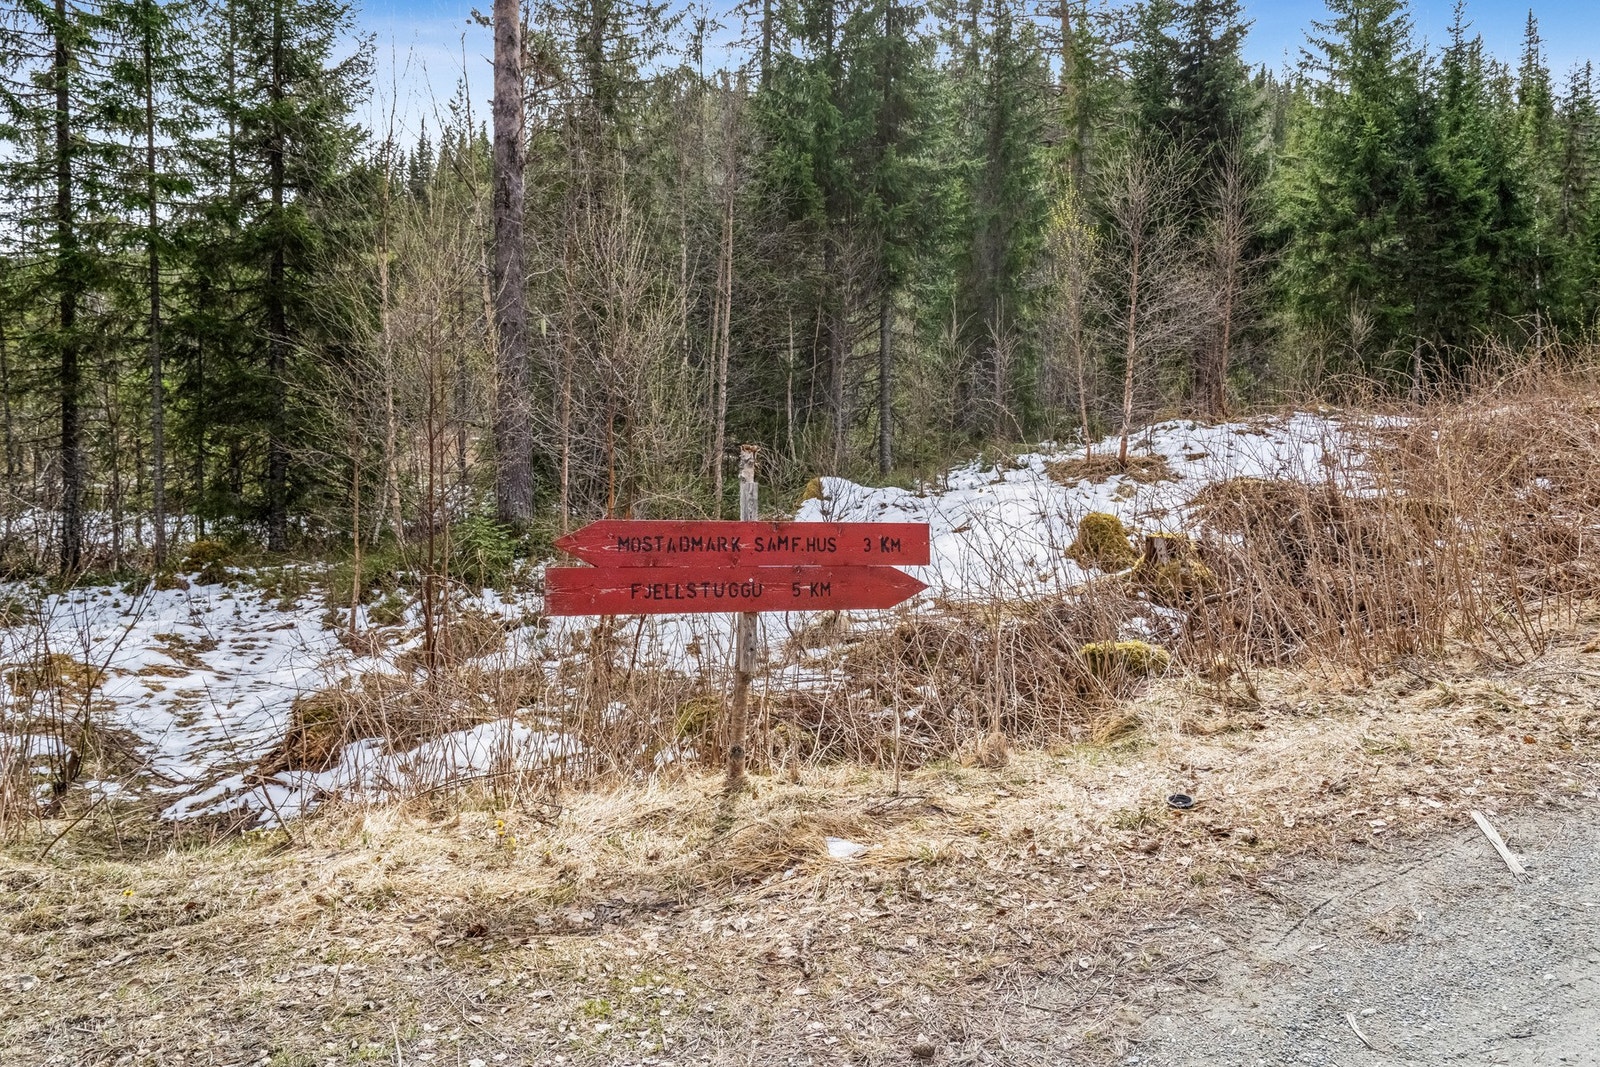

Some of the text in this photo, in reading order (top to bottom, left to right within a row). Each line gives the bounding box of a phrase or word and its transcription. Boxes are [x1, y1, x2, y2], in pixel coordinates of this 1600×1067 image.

[617, 536, 901, 553] MOSTADMARK SAMF.HUS 3 KM
[630, 582, 831, 600] FJELLSTUGGU 5 KM
